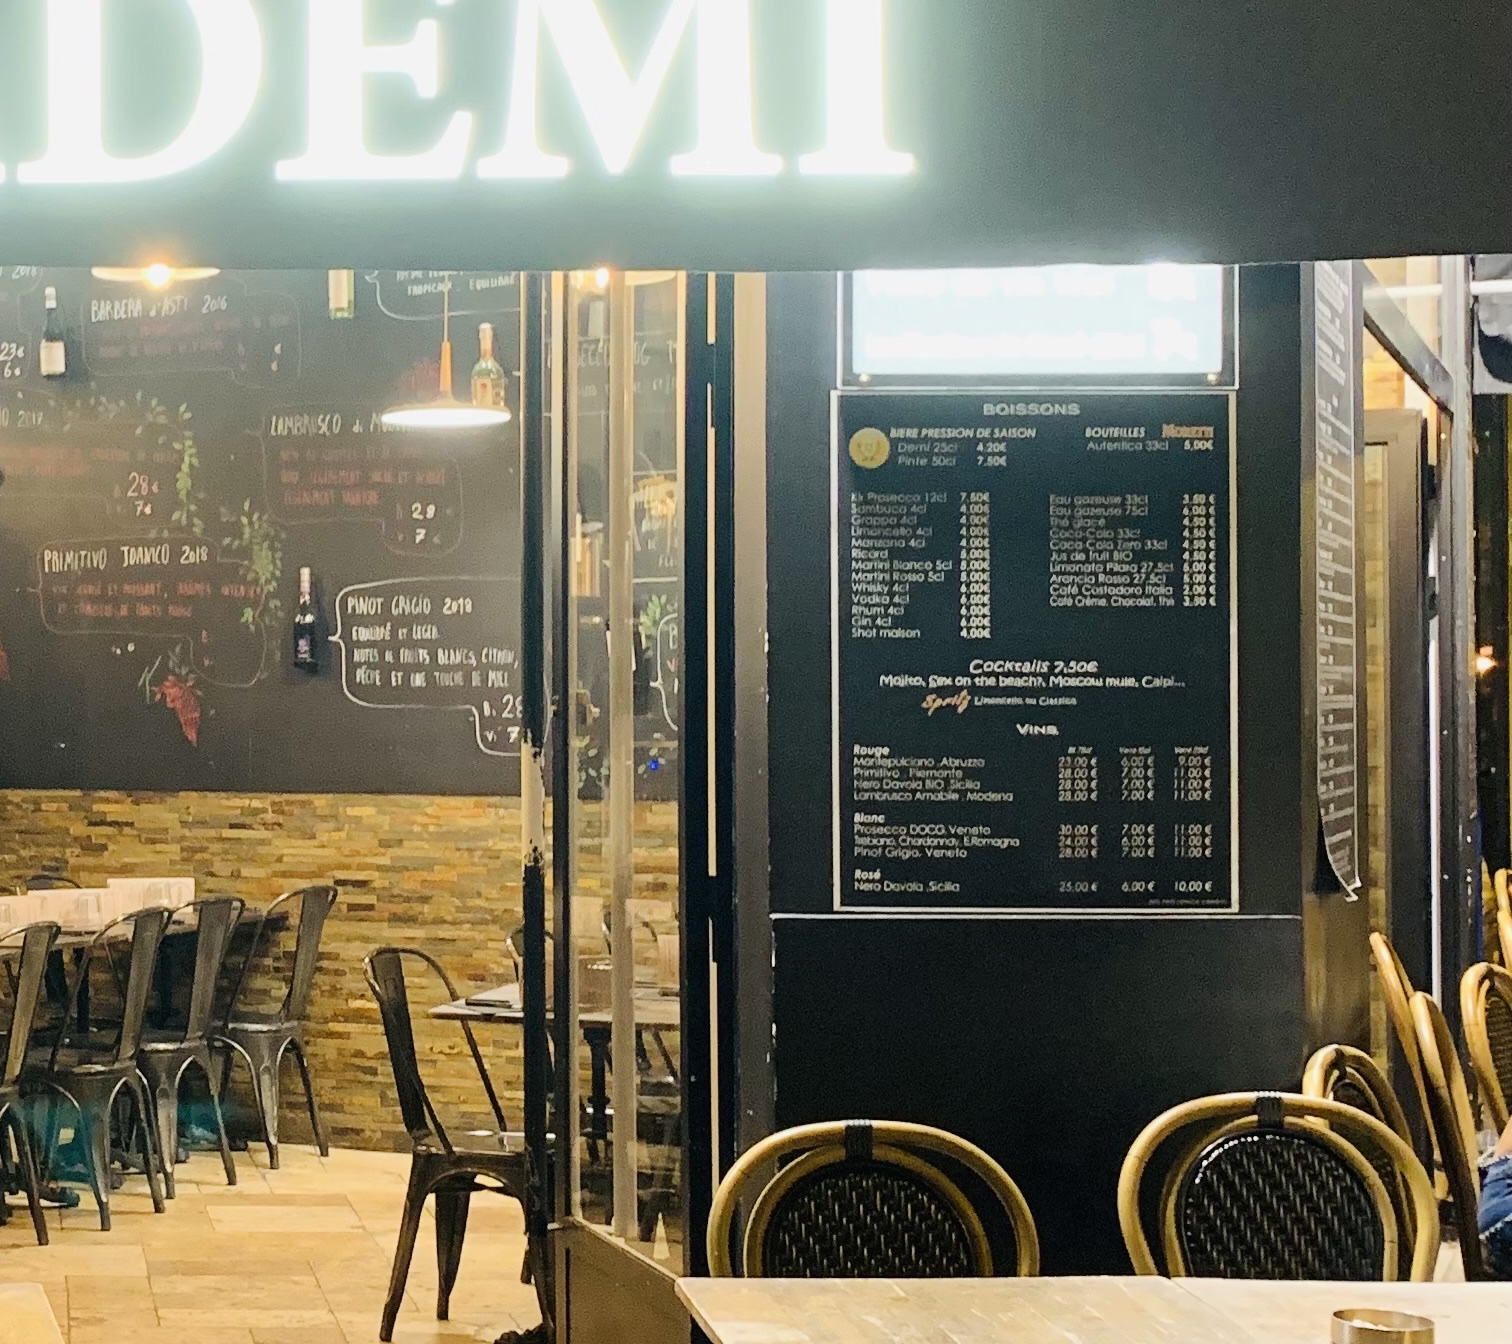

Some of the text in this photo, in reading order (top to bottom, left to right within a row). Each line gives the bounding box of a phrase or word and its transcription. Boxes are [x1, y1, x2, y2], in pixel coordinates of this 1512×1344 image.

[91, 299, 142, 322] BARBERA
[983, 404, 1081, 415] BOISSONS
[270, 414, 341, 436] LAMBRUSCO
[920, 428, 974, 438] PRESSION
[976, 428, 988, 438] DE
[993, 428, 1036, 438] SAISON
[1085, 427, 1145, 438] BOUTEILLES
[898, 443, 929, 453] Demi
[1087, 440, 1143, 451] Autentica
[898, 456, 928, 466] Pinte
[1049, 494, 1071, 504] Eau
[1049, 506, 1071, 516] Eau
[851, 515, 897, 526] Grappa
[43, 544, 209, 573] PRIMITIVO JOANICO 2018
[851, 549, 888, 558] Ricard
[851, 560, 953, 570] Martini Bianco 5cl
[851, 572, 945, 582] Martini Rosso 5cl
[1049, 574, 1095, 584] Arancia
[851, 583, 910, 594] Whisky 4cl
[1049, 585, 1078, 595] Café
[1082, 585, 1142, 595] Costadoro
[851, 594, 910, 604] Vodka 4cl
[347, 593, 473, 616] PINOT GRIGIO 2018
[851, 605, 904, 615] Rhum 4cl
[851, 616, 892, 626] Gin 4cl
[851, 628, 921, 638] Shot maison
[353, 648, 379, 663] NOTES
[400, 647, 430, 665] FRUITS
[969, 659, 1050, 674] Cocktails
[391, 671, 403, 687] ET
[434, 671, 464, 687] TOUCHE
[488, 670, 509, 688] MIEL
[955, 676, 971, 686] on
[974, 676, 997, 686] the
[1049, 675, 1103, 687] Moscow
[854, 744, 890, 757] Rouge
[853, 768, 900, 778] Primitivo
[854, 780, 880, 789] Nero
[854, 791, 912, 801] Lambrusco
[854, 812, 885, 823] Blanc
[854, 824, 906, 835] Prosecco
[948, 825, 991, 835] Veneto
[854, 847, 967, 858] Pinot Veneto
[854, 868, 881, 880] Rosé
[854, 881, 881, 891] Nero
